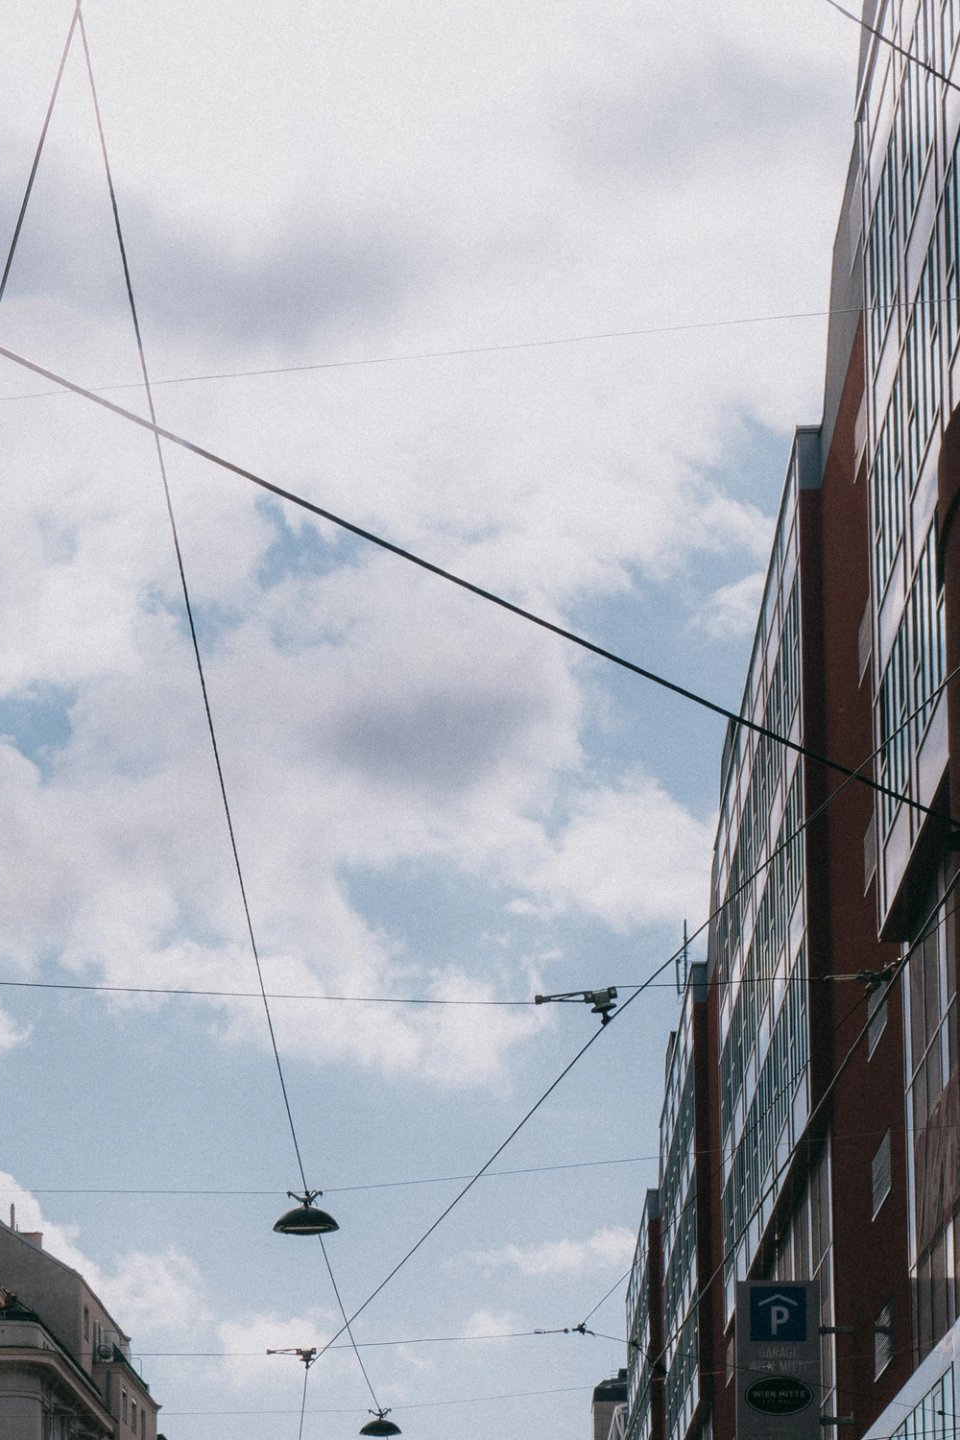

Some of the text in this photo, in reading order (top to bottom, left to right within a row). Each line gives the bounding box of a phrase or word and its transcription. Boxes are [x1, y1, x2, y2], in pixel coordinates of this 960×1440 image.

[771, 1305, 790, 1336] P
[758, 1346, 798, 1358] GARAGE
[752, 1390, 806, 1398] WIEN MITTE
